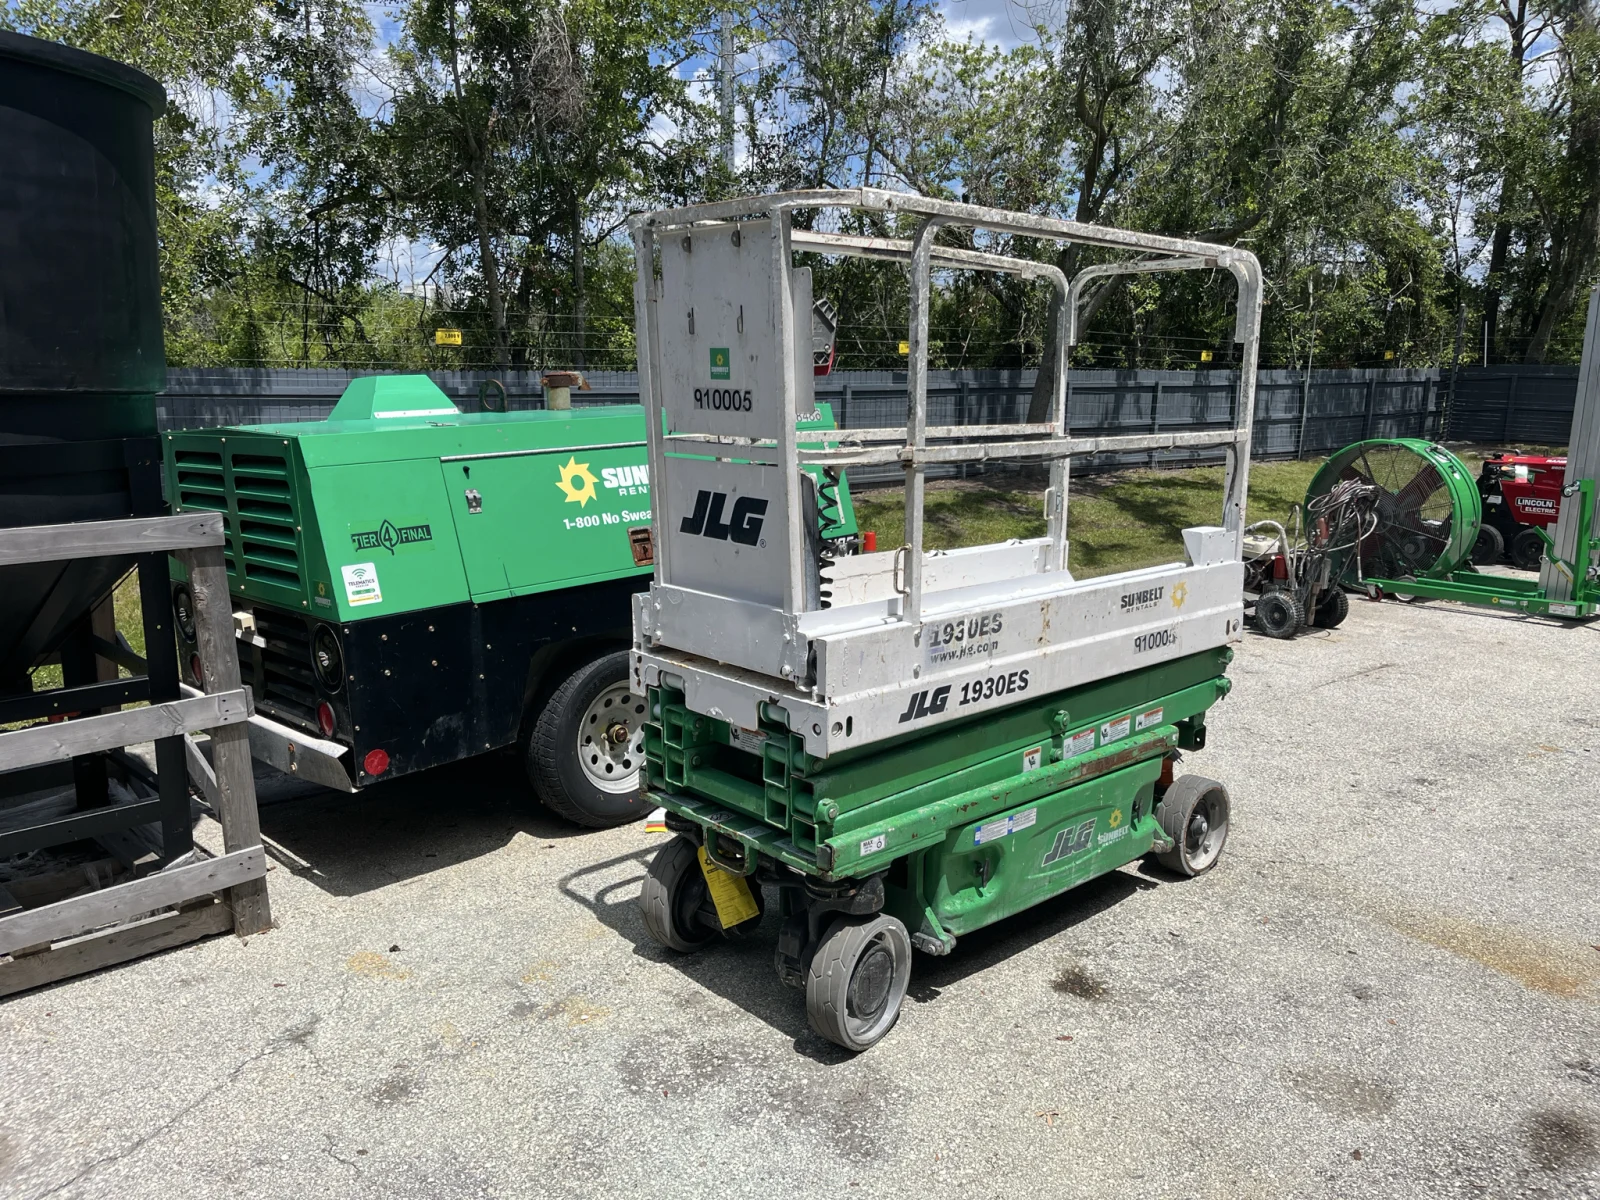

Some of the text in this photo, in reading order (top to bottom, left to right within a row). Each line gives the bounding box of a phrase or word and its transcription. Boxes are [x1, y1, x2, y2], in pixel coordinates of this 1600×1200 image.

[694, 388, 752, 412] 910005
[601, 464, 650, 489] SUN
[618, 485, 651, 497] REN
[1517, 498, 1553, 508] LINCOLN
[563, 514, 600, 530] 1-800
[601, 512, 620, 525] No
[680, 489, 769, 547] JLG
[1525, 506, 1556, 514] ELECTRIC
[352, 525, 432, 549] TIER 4 FINAL
[348, 578, 375, 587] TELEMATICS
[1120, 586, 1164, 610] SUNBELT
[929, 612, 1004, 648] 1930ES
[898, 669, 1030, 724] JLG 1930ES
[1041, 816, 1098, 868] JLG
